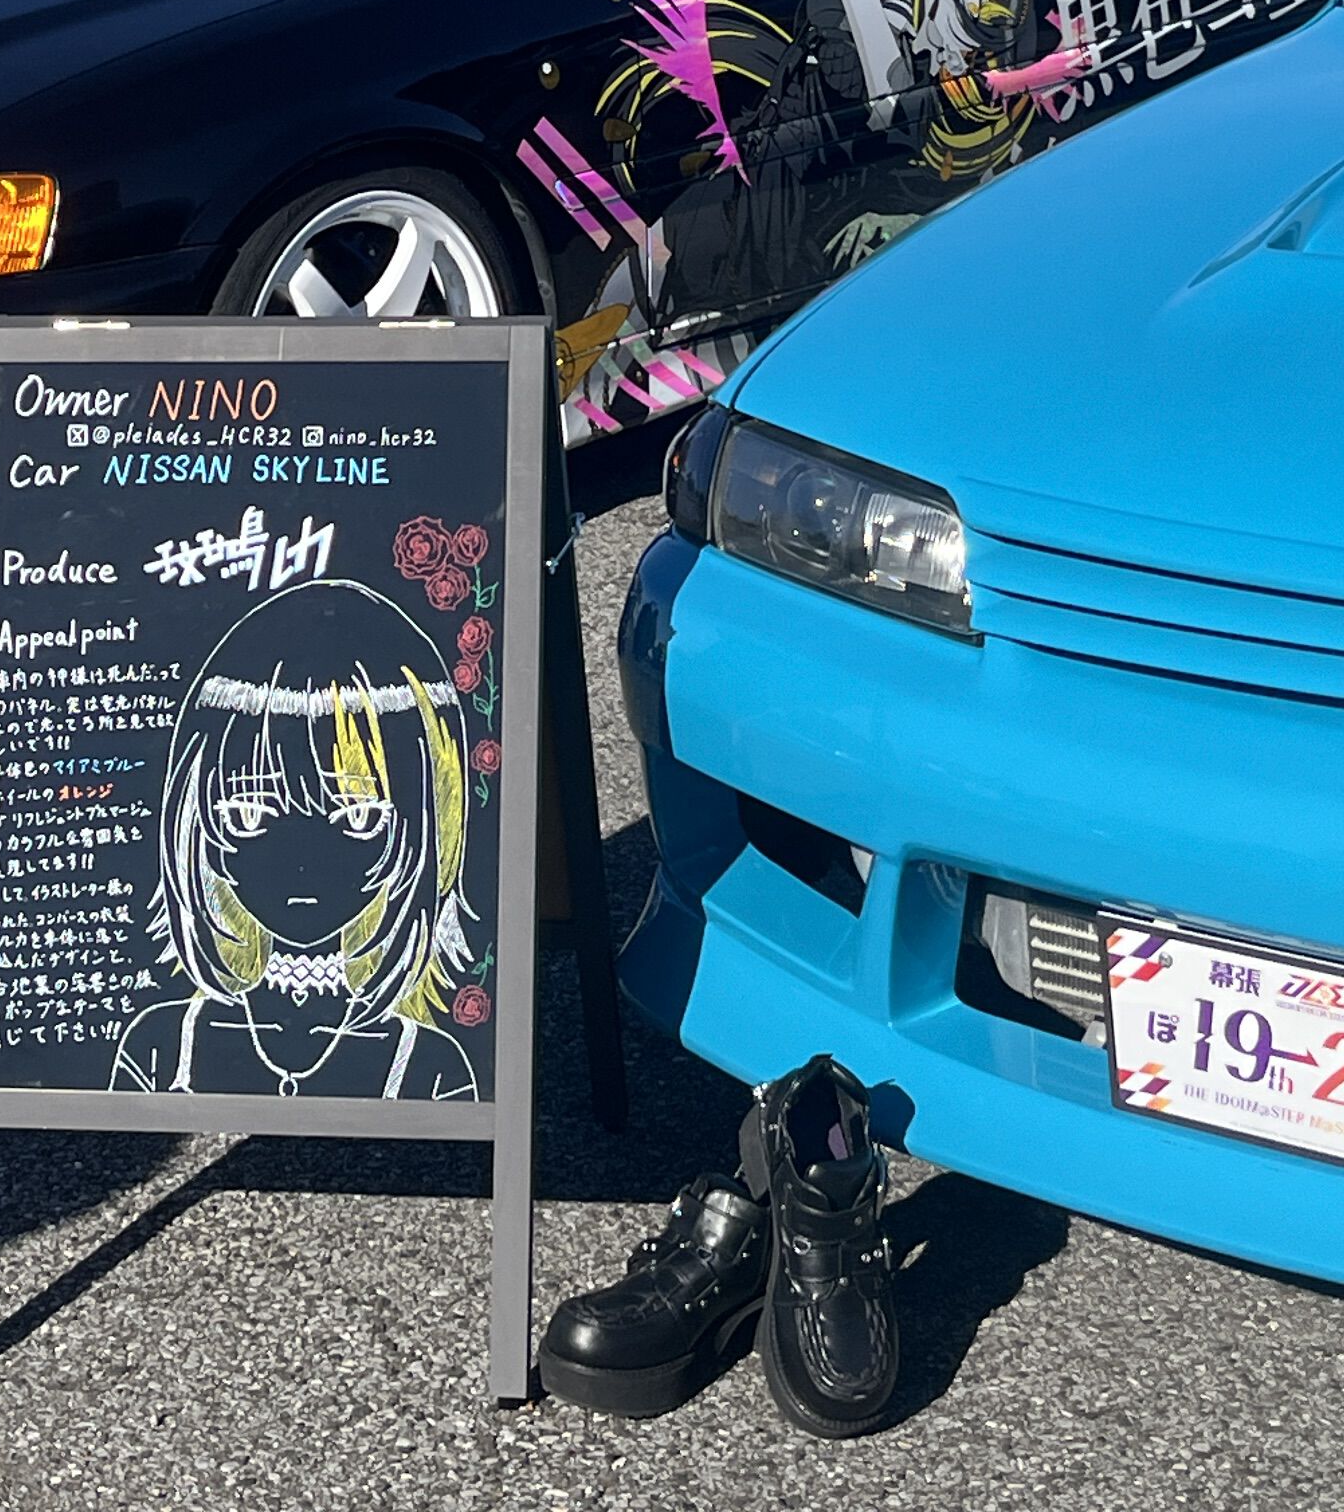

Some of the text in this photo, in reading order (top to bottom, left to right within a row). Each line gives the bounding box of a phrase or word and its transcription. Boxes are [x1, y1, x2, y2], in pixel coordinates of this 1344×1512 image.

[14, 373, 278, 421] Owner NINO
[9, 453, 390, 488] Car NISSAN SKYLINE
[3, 549, 118, 587] Produce
[1208, 959, 1262, 997] 幕張
[1183, 1083, 1208, 1101] THE
